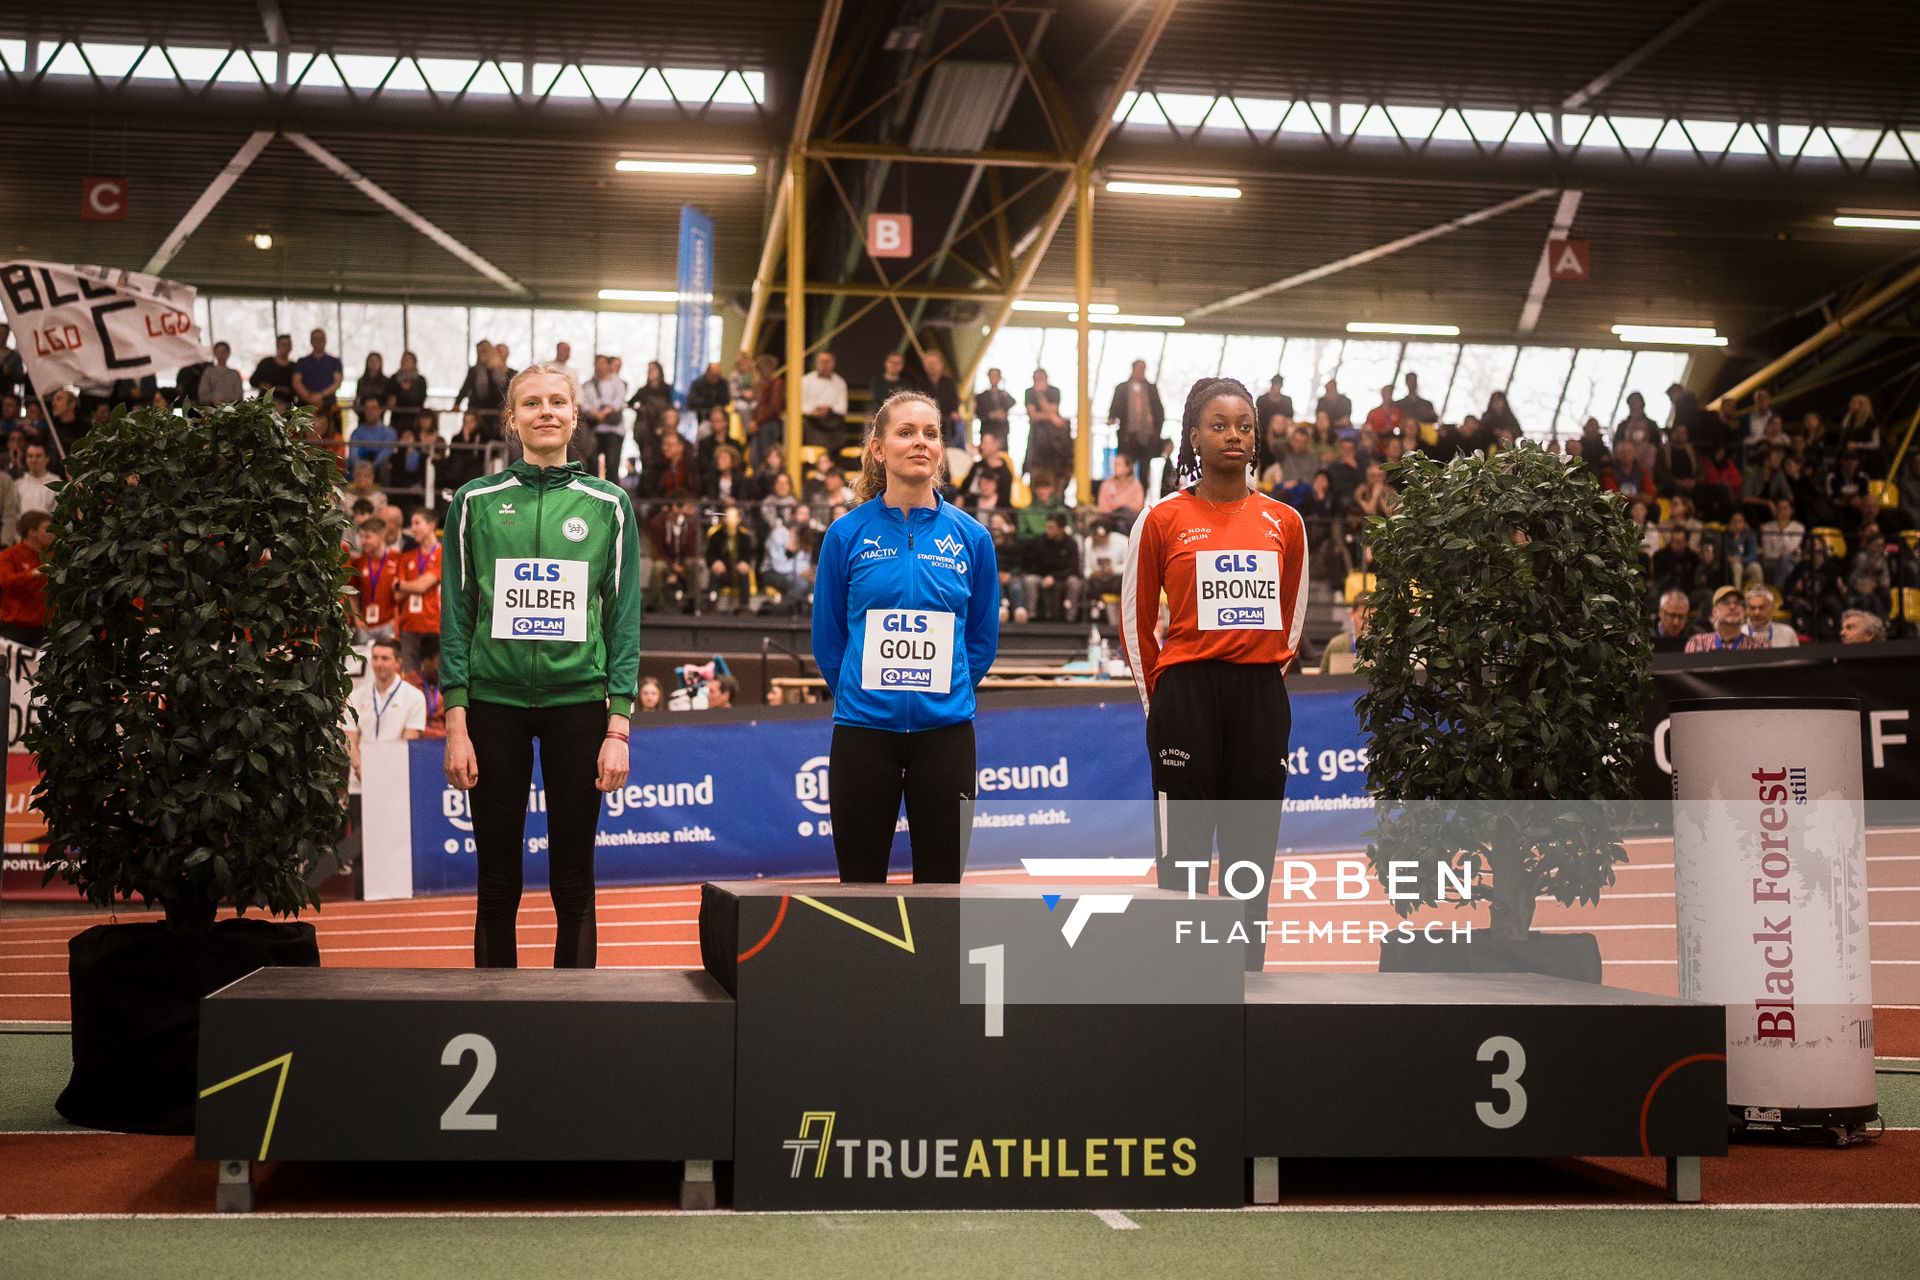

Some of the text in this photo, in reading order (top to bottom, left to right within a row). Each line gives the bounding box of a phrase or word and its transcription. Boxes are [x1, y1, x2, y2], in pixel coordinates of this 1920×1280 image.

[90, 182, 121, 214] C
[875, 219, 901, 250] B
[1555, 244, 1583, 274] A
[1183, 533, 1208, 544] BERLIN
[1188, 527, 1212, 535] NORD
[859, 547, 898, 560] VIACTIV
[505, 588, 576, 611] SILBER
[1202, 580, 1276, 600] BRONZE
[533, 620, 563, 630] PLAN
[1239, 610, 1263, 619] PLAN
[880, 639, 936, 661] GOLD
[901, 671, 930, 681] PLAN
[1162, 759, 1186, 767] BERLIN
[1168, 748, 1191, 760] NORD
[1318, 748, 1371, 781] ges
[975, 756, 1069, 795] esund
[1789, 767, 1808, 806] still
[605, 774, 715, 818] gesund
[674, 825, 716, 843] nicht.
[1751, 766, 1797, 1042] Black Forest
[968, 943, 1005, 1037] 1
[440, 1033, 498, 1131] 2
[1475, 1035, 1528, 1129] 3
[836, 1137, 1197, 1179] TRUEATHLETES
